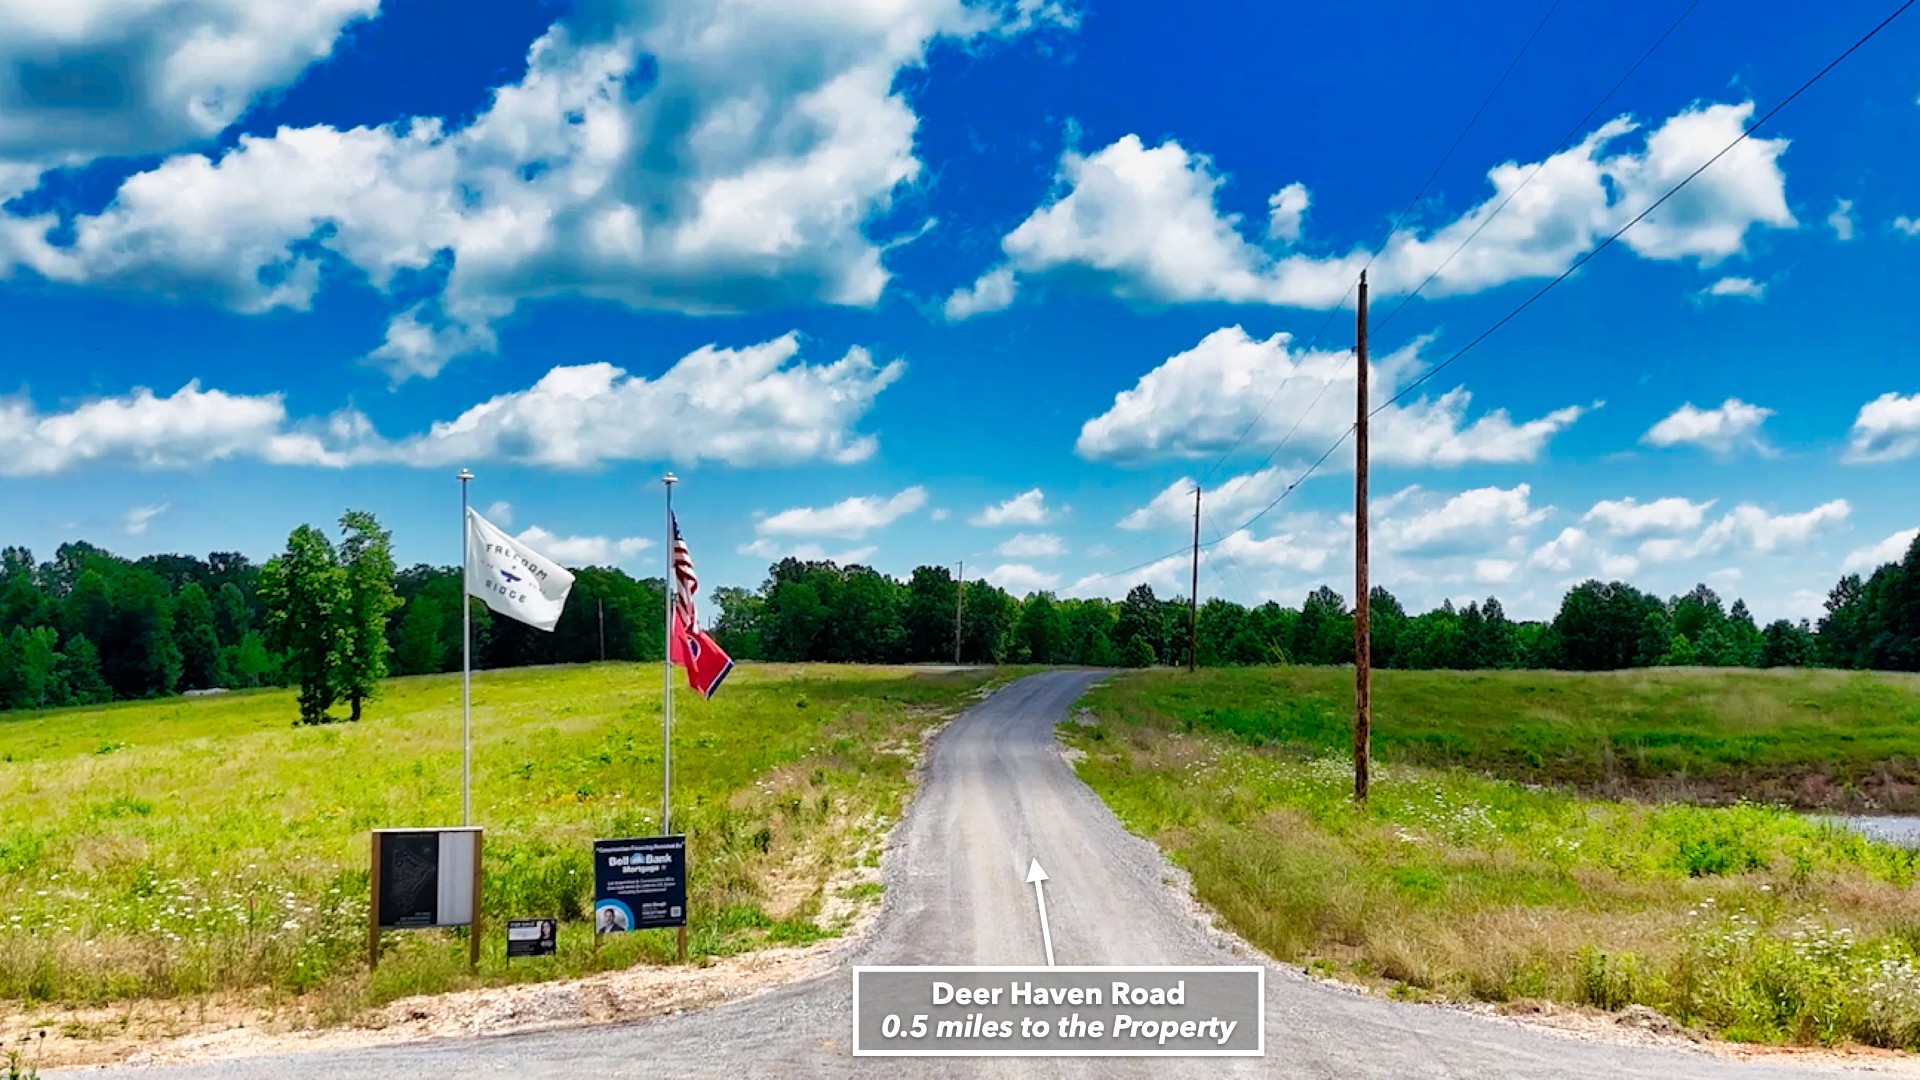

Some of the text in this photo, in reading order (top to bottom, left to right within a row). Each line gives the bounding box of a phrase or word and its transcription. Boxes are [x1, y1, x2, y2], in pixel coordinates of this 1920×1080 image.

[485, 579, 527, 603] RIDGE
[608, 852, 672, 867] Bell Bank
[622, 864, 660, 874] Mortgage
